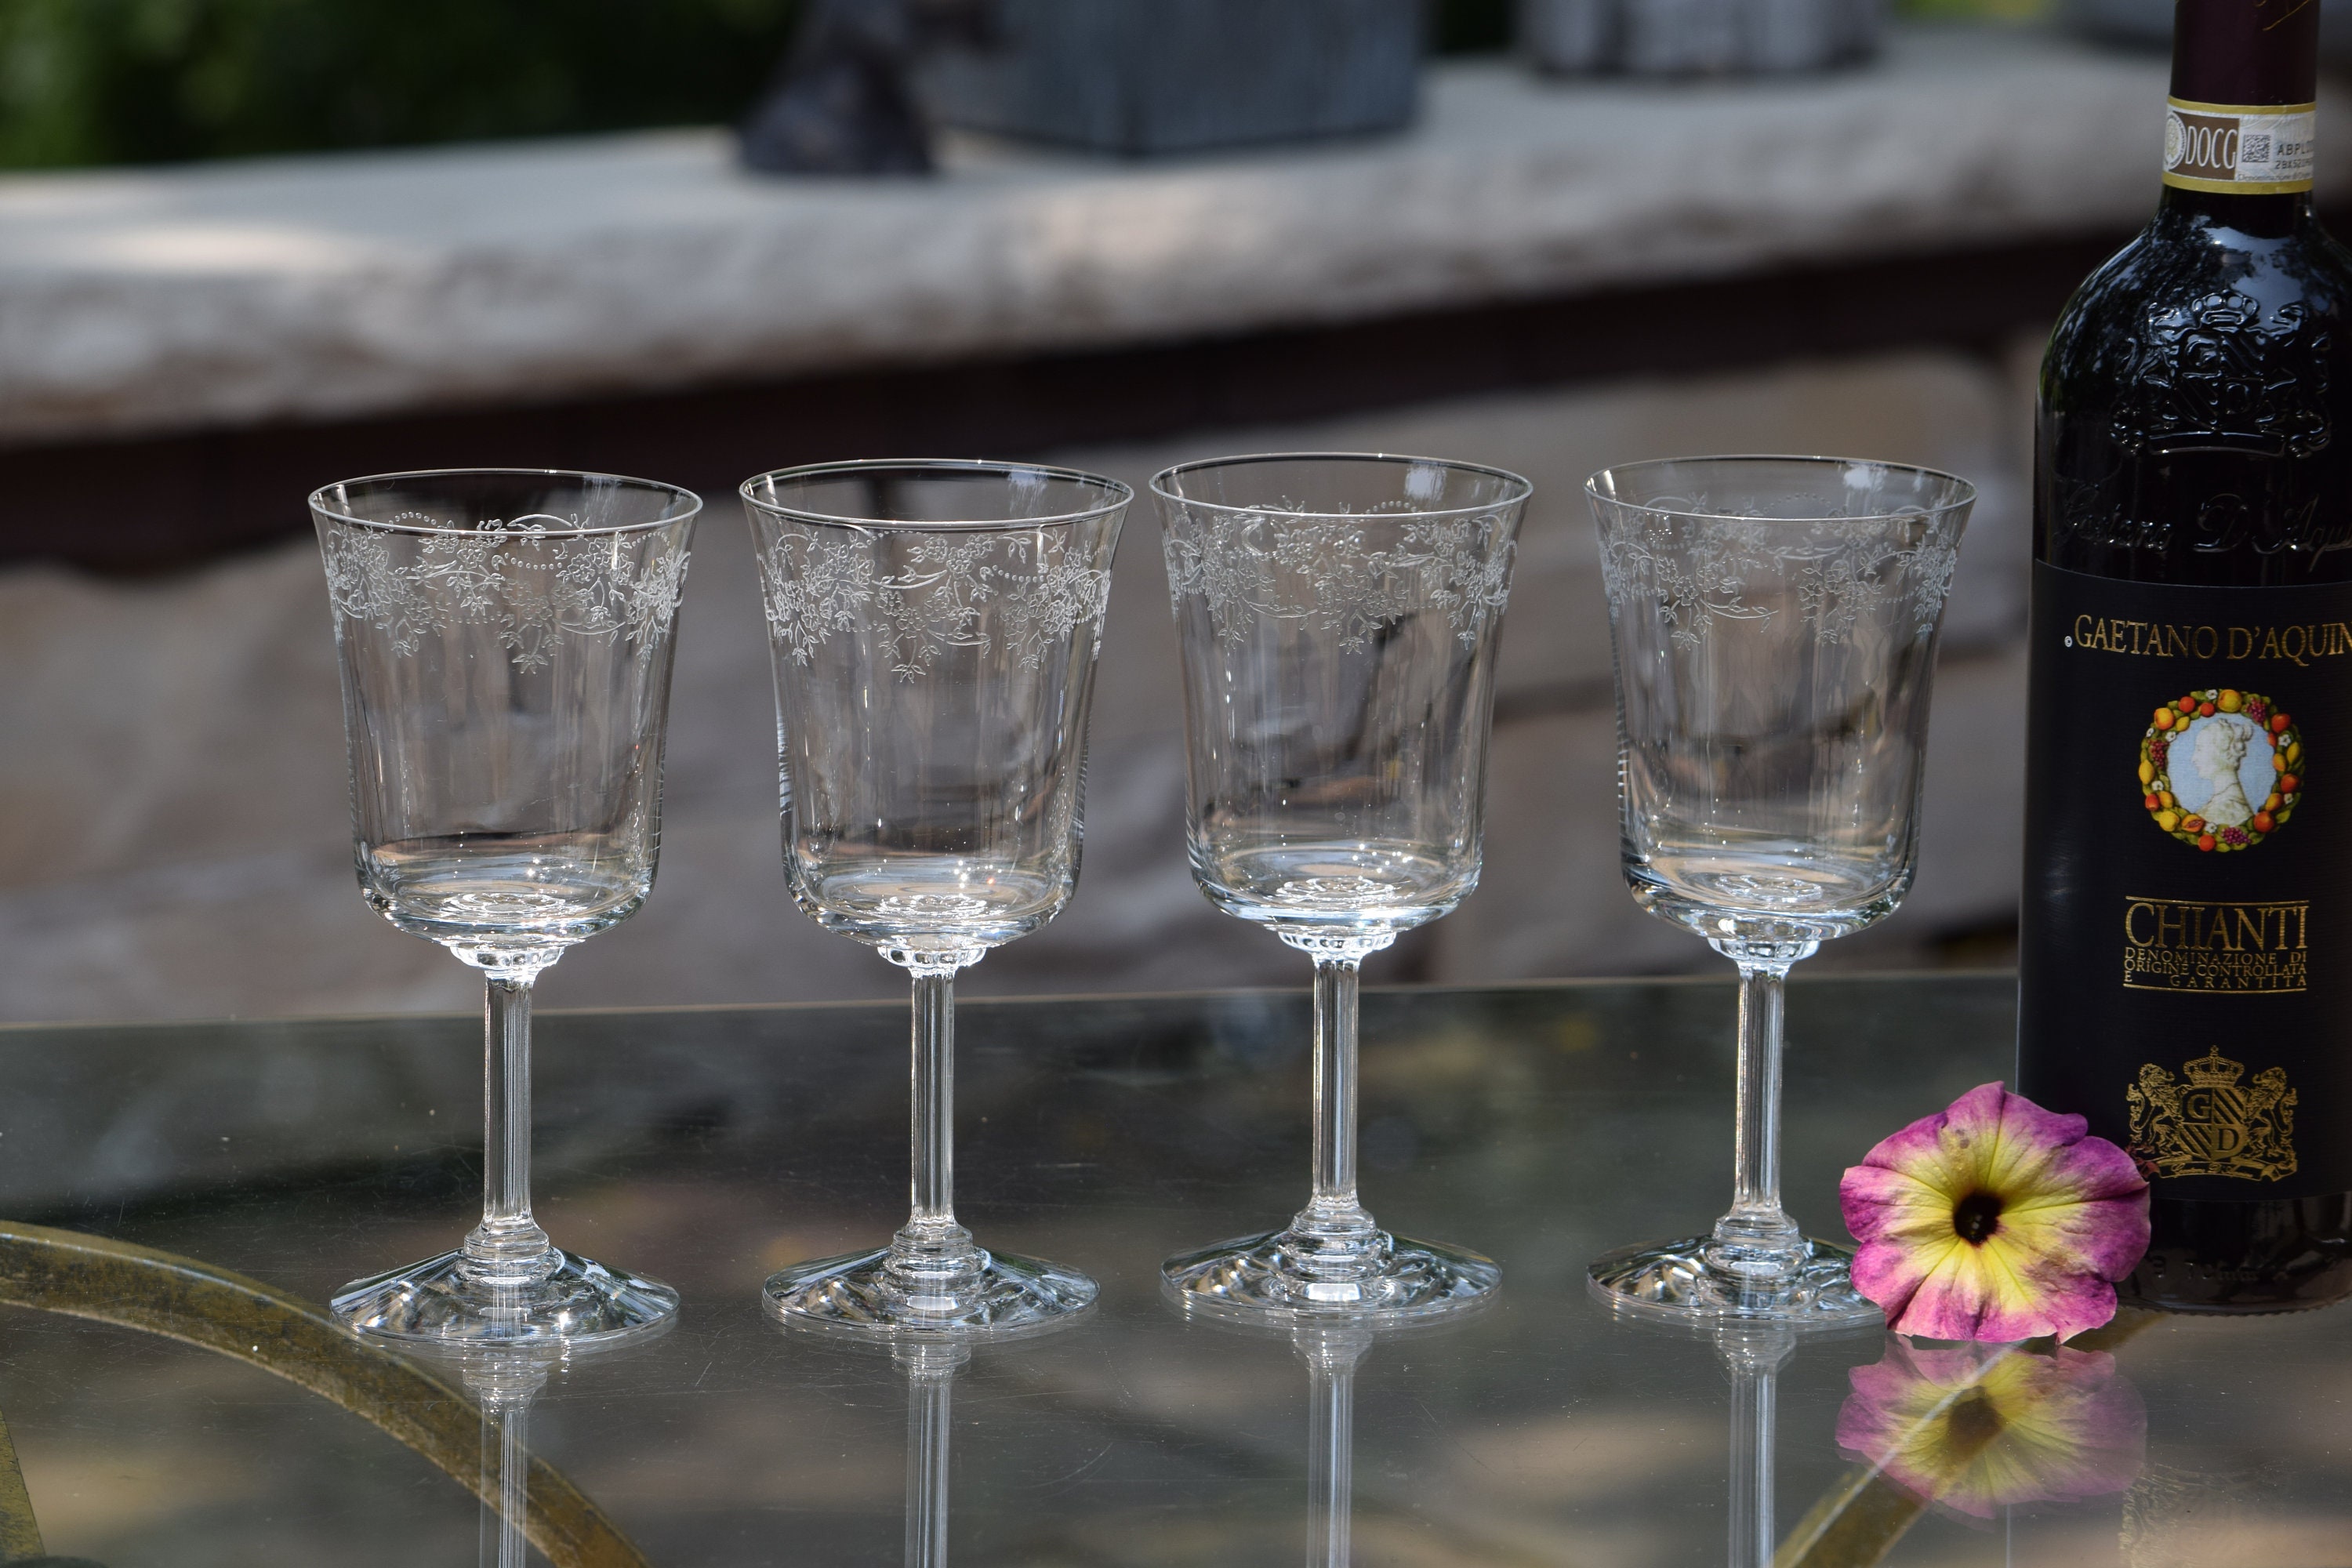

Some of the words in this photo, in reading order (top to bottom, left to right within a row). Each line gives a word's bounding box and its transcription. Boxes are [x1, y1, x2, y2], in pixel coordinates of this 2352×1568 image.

[2185, 125, 2238, 170] DOCG
[2074, 614, 2219, 660] GAETANO
[2124, 902, 2310, 952] CHIANTI
[2123, 959, 2190, 976] ORIGINE
[2195, 964, 2307, 978] CONTROLLATA
[2124, 946, 2278, 965] DENOMINAZIONE
[2290, 950, 2307, 964] DI
[2123, 970, 2133, 983] E
[2169, 975, 2307, 989] GARANTITA
[2186, 1093, 2210, 1120] G
[2218, 1127, 2240, 1152] D
